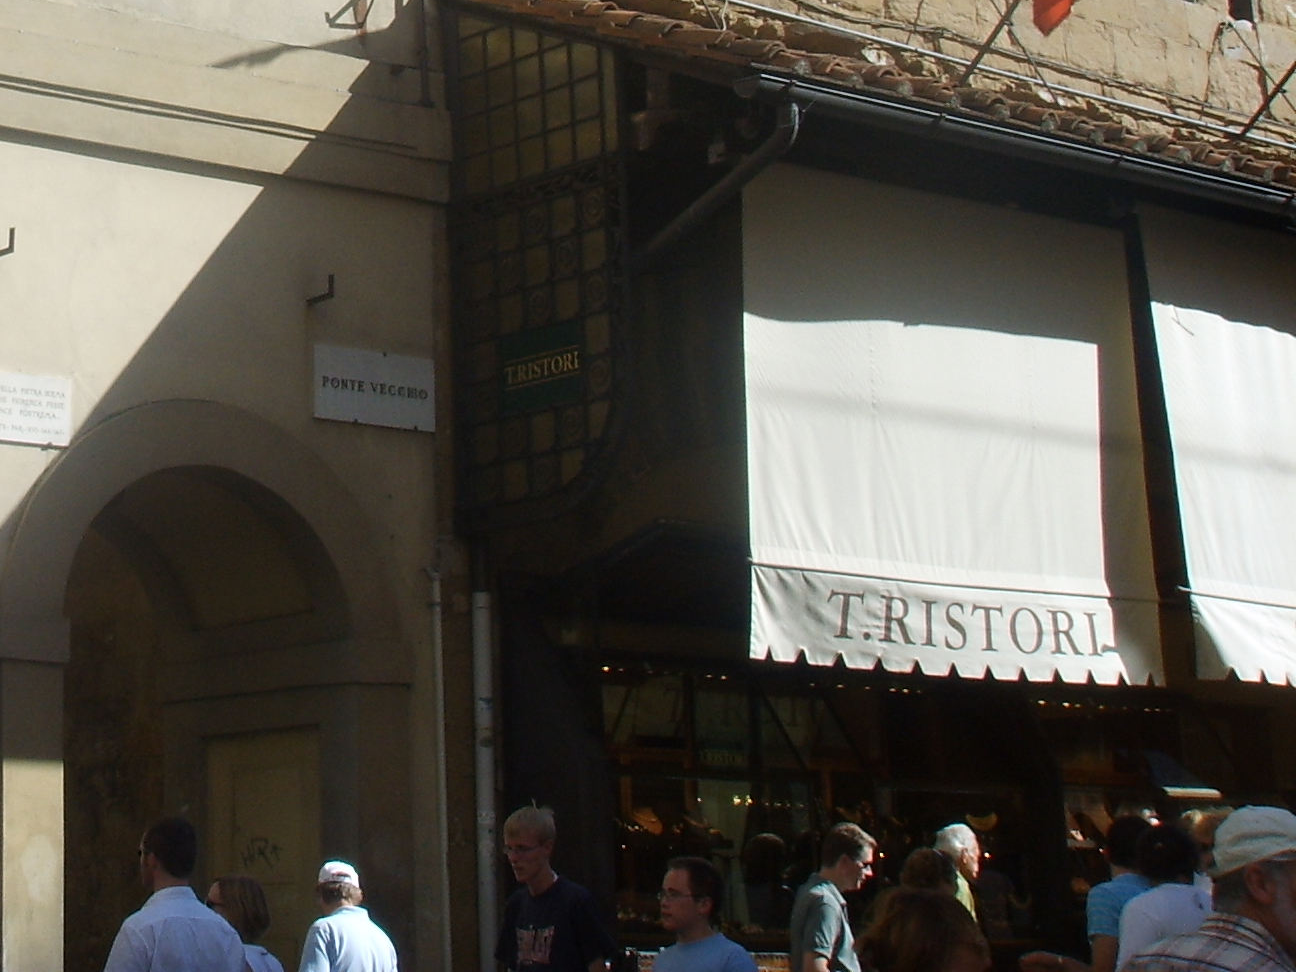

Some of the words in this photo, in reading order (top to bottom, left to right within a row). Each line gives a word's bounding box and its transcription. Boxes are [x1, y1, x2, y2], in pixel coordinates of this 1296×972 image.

[322, 375, 365, 392] PONTE
[370, 382, 429, 400] VECCHIO
[826, 588, 1103, 657] T.RISTORI
